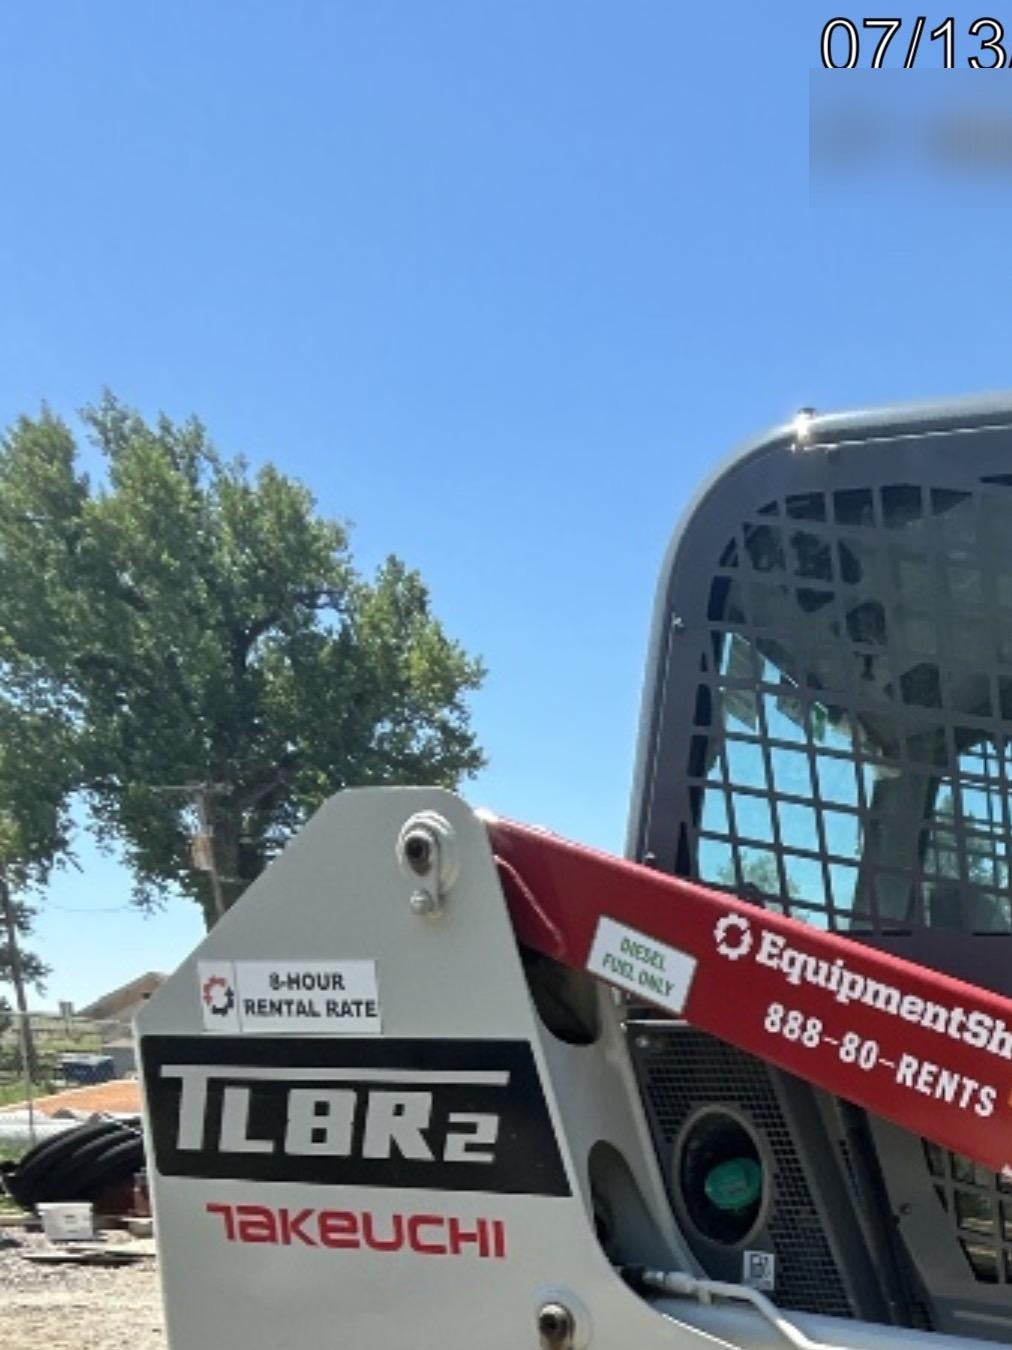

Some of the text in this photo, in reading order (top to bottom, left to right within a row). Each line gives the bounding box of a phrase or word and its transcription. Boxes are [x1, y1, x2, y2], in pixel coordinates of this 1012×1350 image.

[620, 936, 666, 972] DIESEL
[268, 972, 346, 992] 8-HOUR
[602, 953, 675, 997] FUEL ONLY
[243, 998, 378, 1019] RENTAL RATE
[762, 1003, 999, 1118] 888-80-RENTS
[159, 1064, 511, 1164] TL8R2
